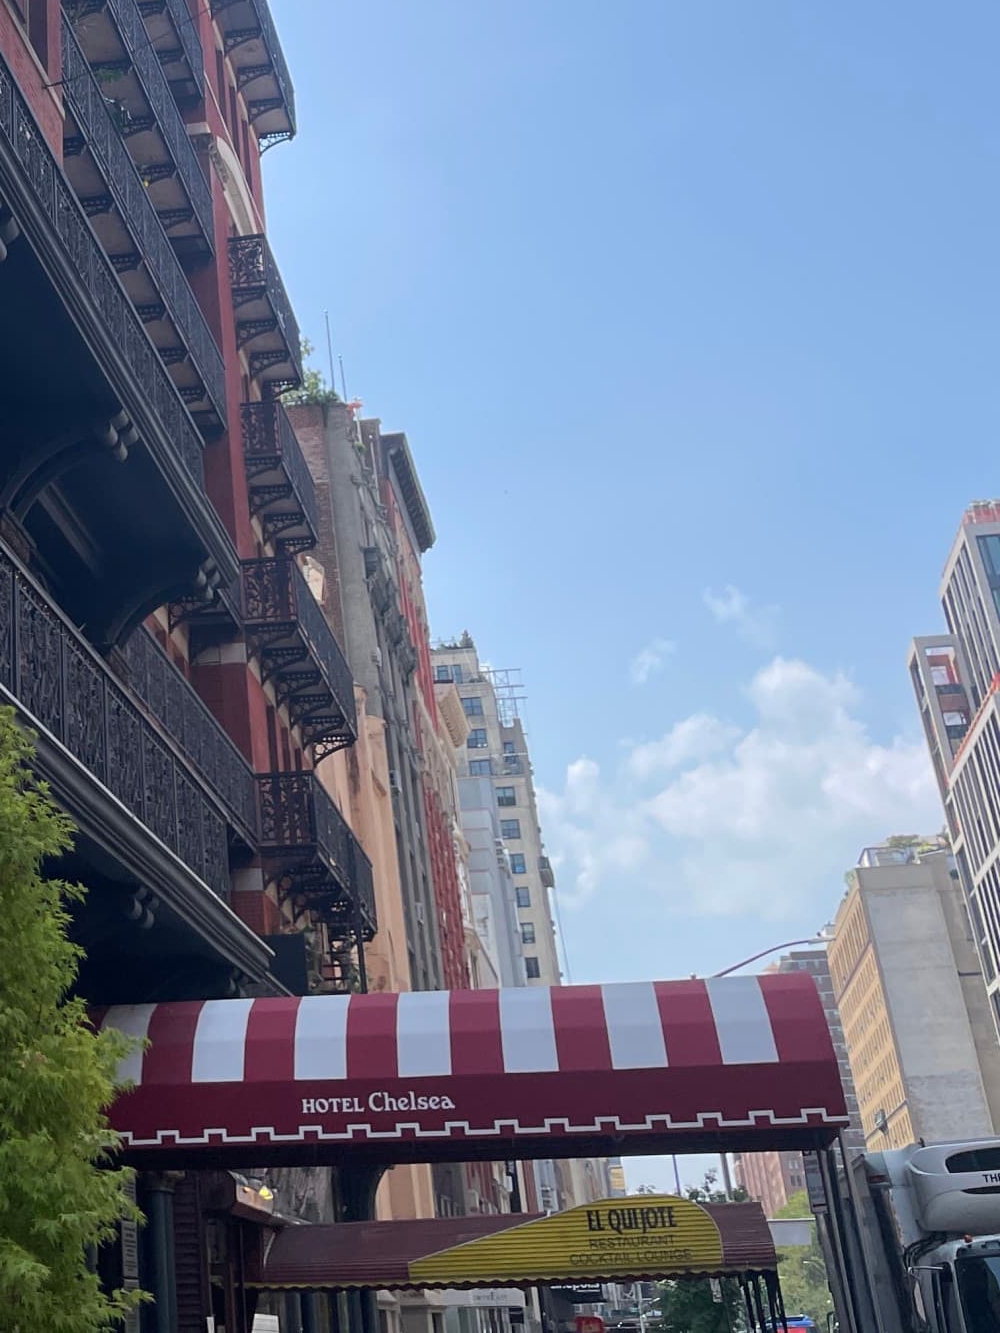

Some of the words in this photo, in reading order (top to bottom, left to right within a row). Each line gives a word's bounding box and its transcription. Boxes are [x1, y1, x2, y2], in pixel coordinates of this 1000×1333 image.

[302, 1097, 365, 1114] HOTEL
[368, 1090, 455, 1112] Chelsea
[586, 1209, 605, 1231] EL
[608, 1206, 678, 1234] QUIJOTE
[589, 1234, 675, 1250] RESTAURANT
[569, 1251, 634, 1265] COCKTAIL
[637, 1248, 693, 1263] LOUNGE
